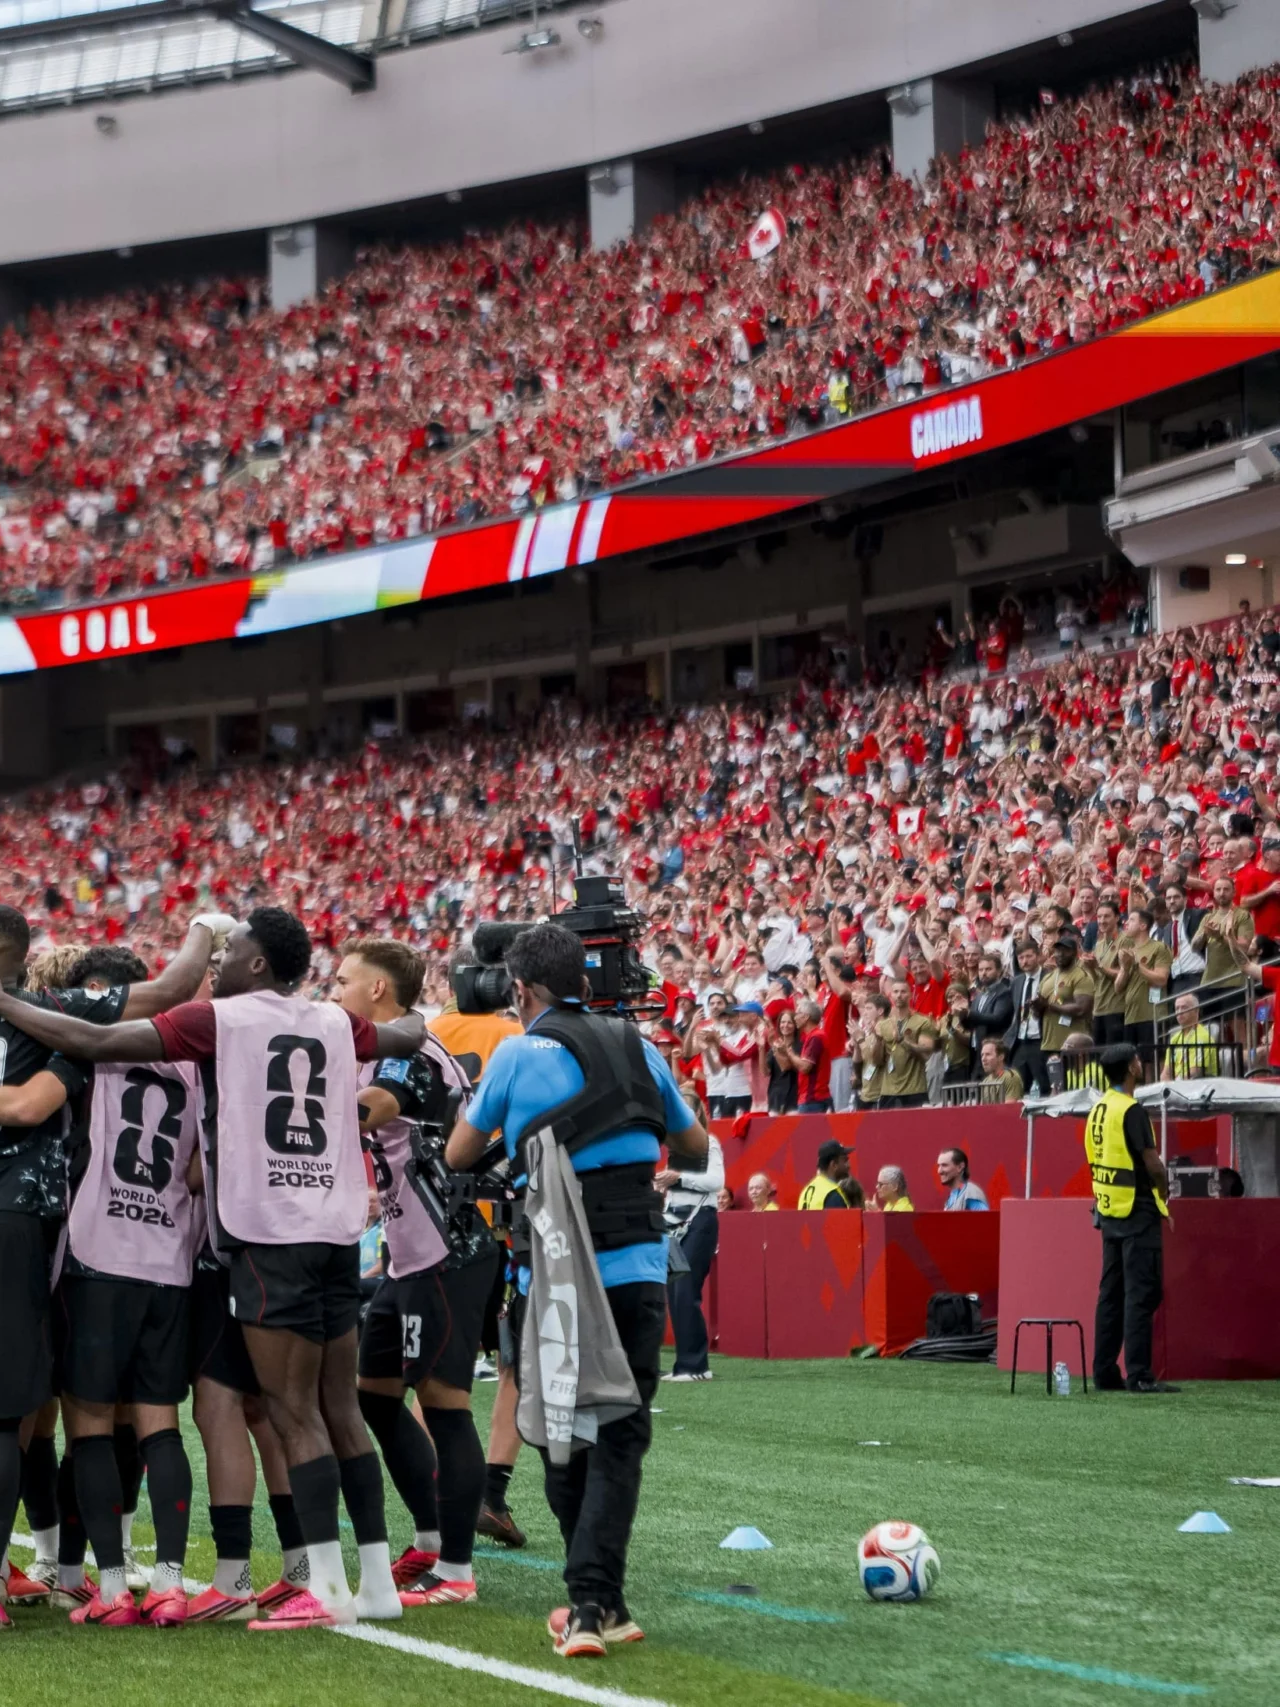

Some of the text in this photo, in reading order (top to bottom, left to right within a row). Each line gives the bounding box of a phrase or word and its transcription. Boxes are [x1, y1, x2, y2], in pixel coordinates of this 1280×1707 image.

[911, 394, 983, 459] CANADA
[60, 602, 157, 657] GOAL
[533, 1040, 566, 1049] HOS
[285, 1131, 313, 1146] FIFA
[267, 1159, 332, 1173] WORLD CUP
[269, 1171, 335, 1190] 2026
[110, 1187, 156, 1205] WORLD
[107, 1201, 176, 1229] 2026
